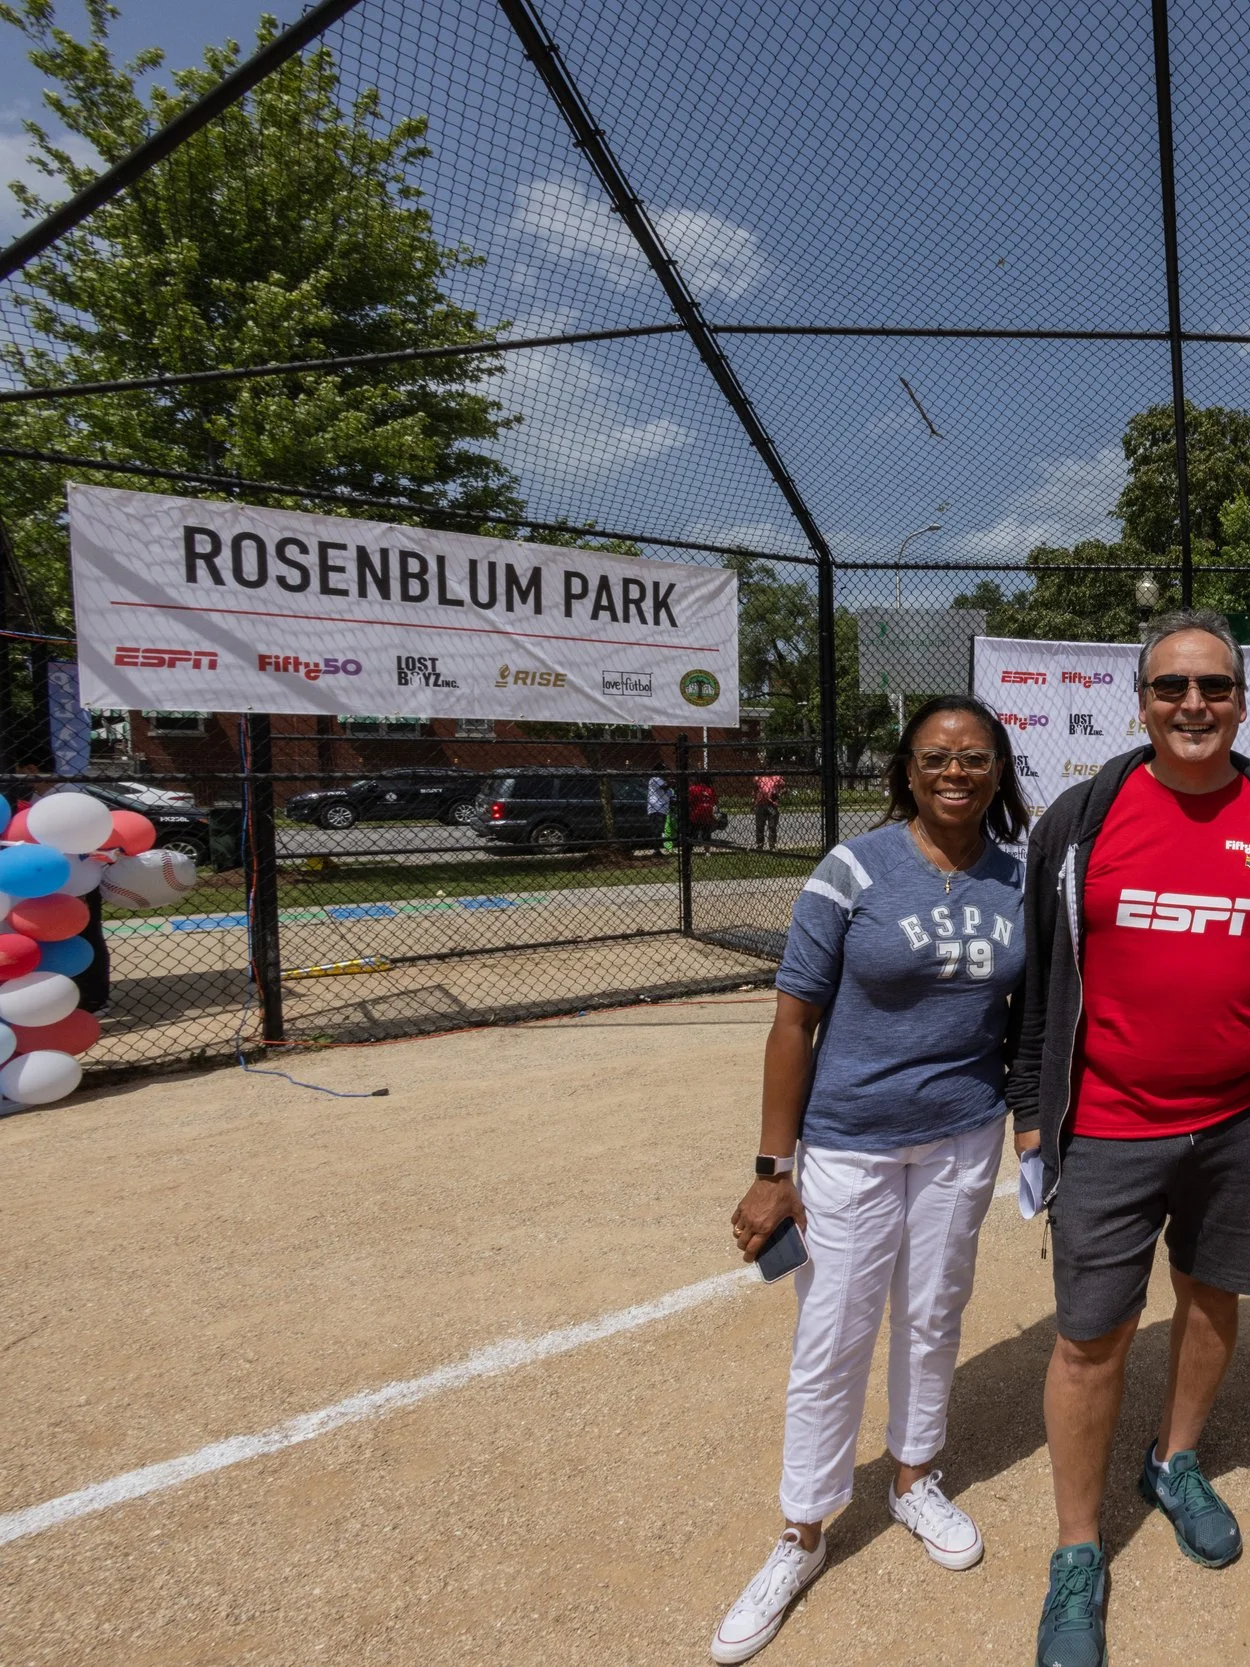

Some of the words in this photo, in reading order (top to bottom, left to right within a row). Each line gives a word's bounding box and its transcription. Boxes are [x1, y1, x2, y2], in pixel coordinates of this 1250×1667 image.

[183, 525, 542, 616] ROSENBLUM
[564, 576, 679, 628] PARK
[114, 646, 218, 670] ESPN
[397, 656, 439, 673] LOST
[257, 654, 363, 681] Fifty50
[513, 670, 567, 688] RISE
[602, 677, 621, 691] love
[1001, 671, 1047, 685] ESPN
[1061, 672, 1113, 688] Fifty50
[1069, 713, 1093, 724] LOST
[1073, 764, 1103, 776] RIS
[898, 904, 1015, 951] ESPN
[936, 938, 994, 979] 79
